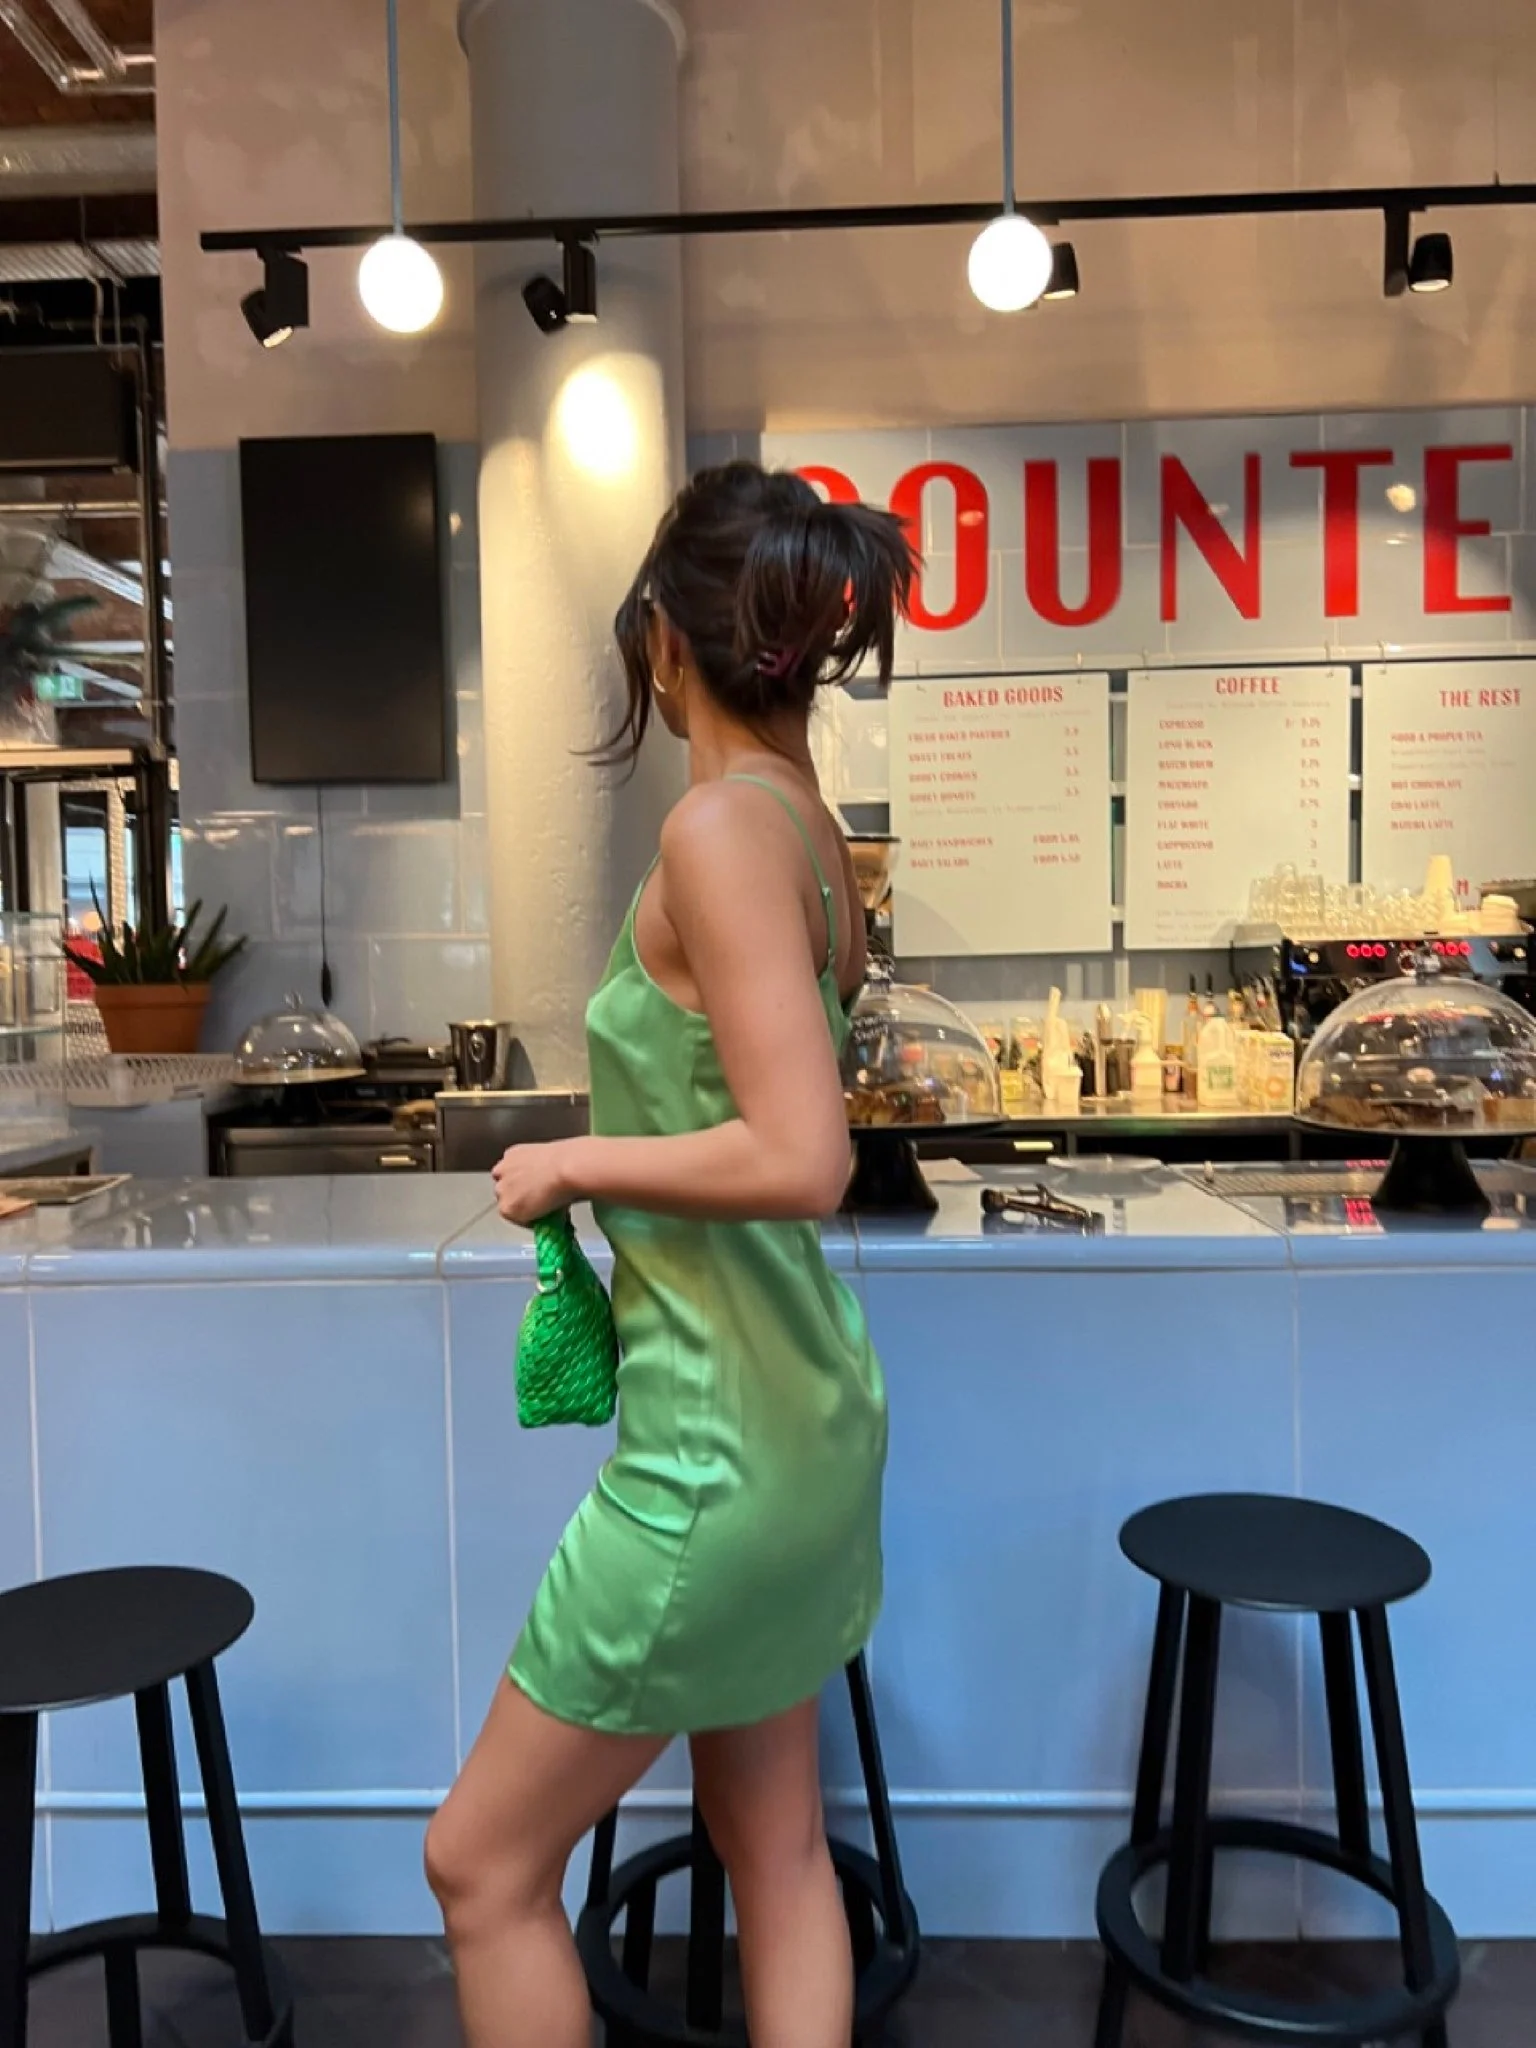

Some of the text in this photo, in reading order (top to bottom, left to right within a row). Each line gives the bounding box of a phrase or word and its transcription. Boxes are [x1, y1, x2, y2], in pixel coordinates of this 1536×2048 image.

[793, 443, 1514, 632] OUNTE
[1215, 676, 1281, 695] COFFEE
[943, 685, 1064, 708] BAKED GOODS
[1439, 688, 1521, 708] THE REST
